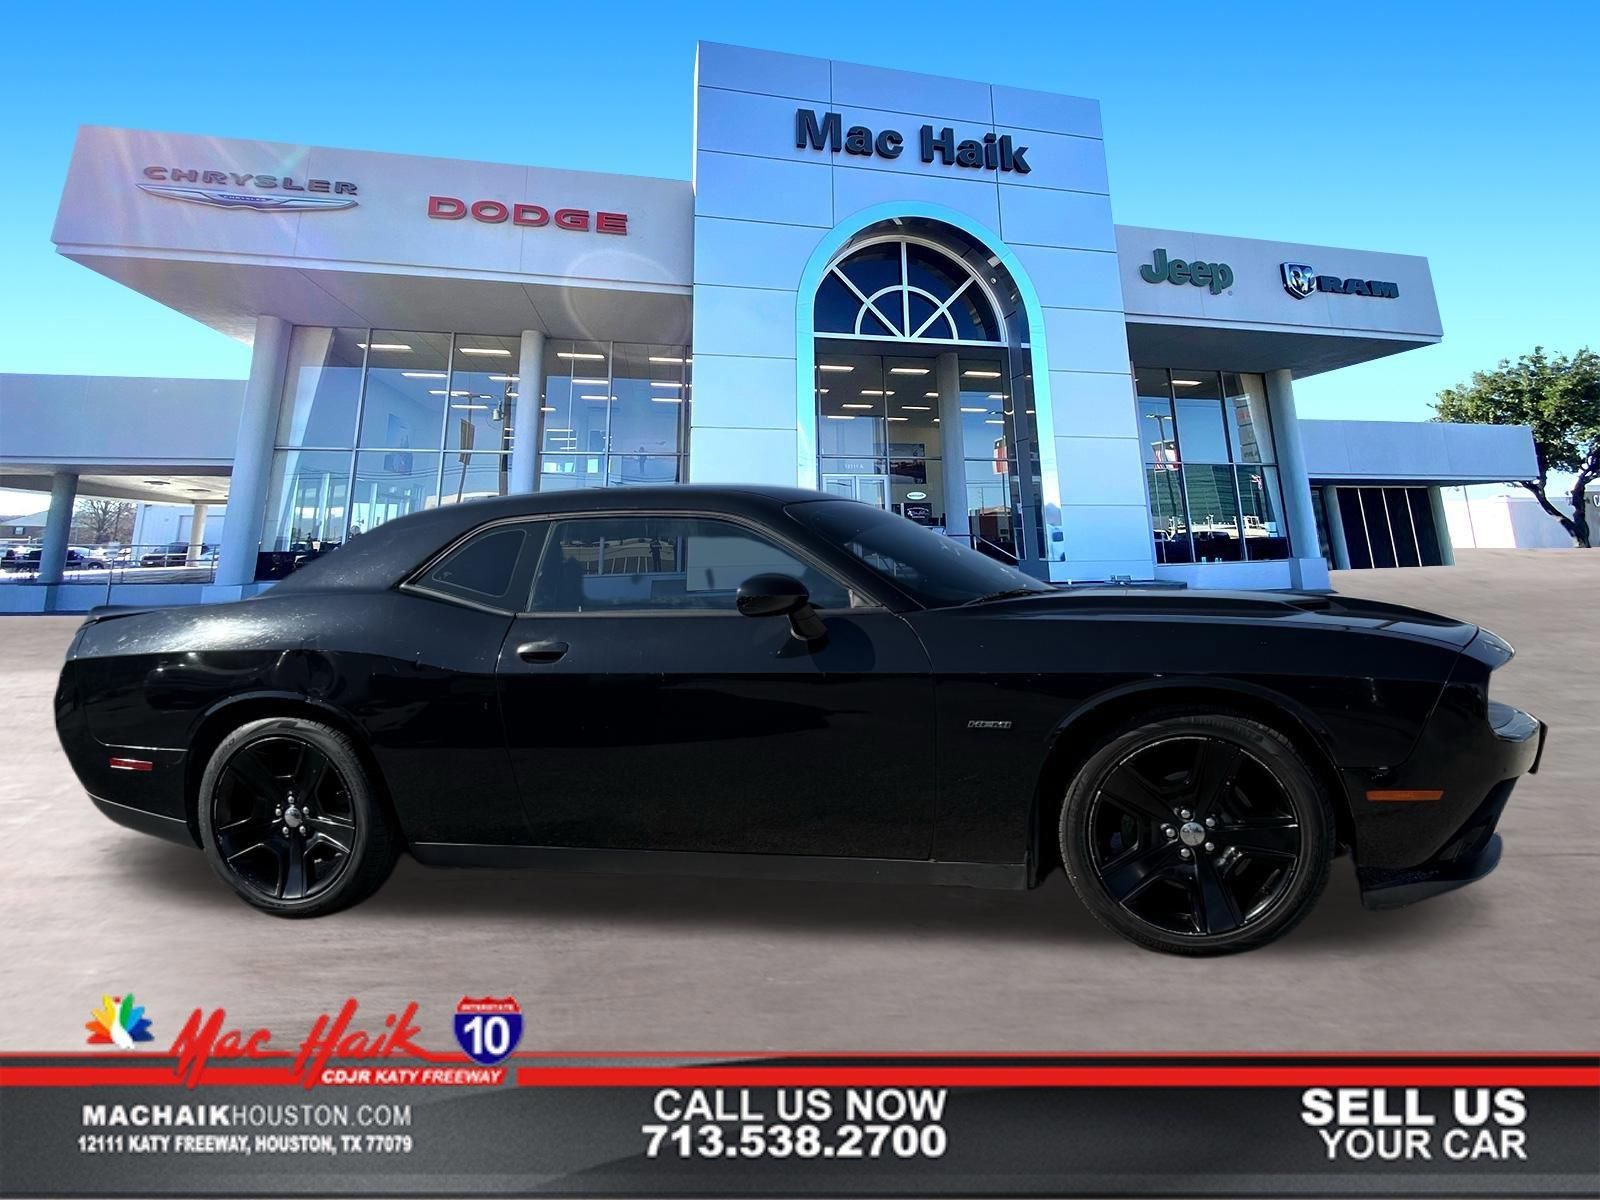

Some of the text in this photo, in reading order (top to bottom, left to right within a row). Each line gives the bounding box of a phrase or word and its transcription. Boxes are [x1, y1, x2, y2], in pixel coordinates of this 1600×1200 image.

[795, 108, 1032, 175] Mac Haik
[142, 166, 360, 196] CHRYSLER
[427, 195, 629, 236] DODGE
[1139, 247, 1234, 296] Jeep
[1319, 274, 1400, 299] RAM
